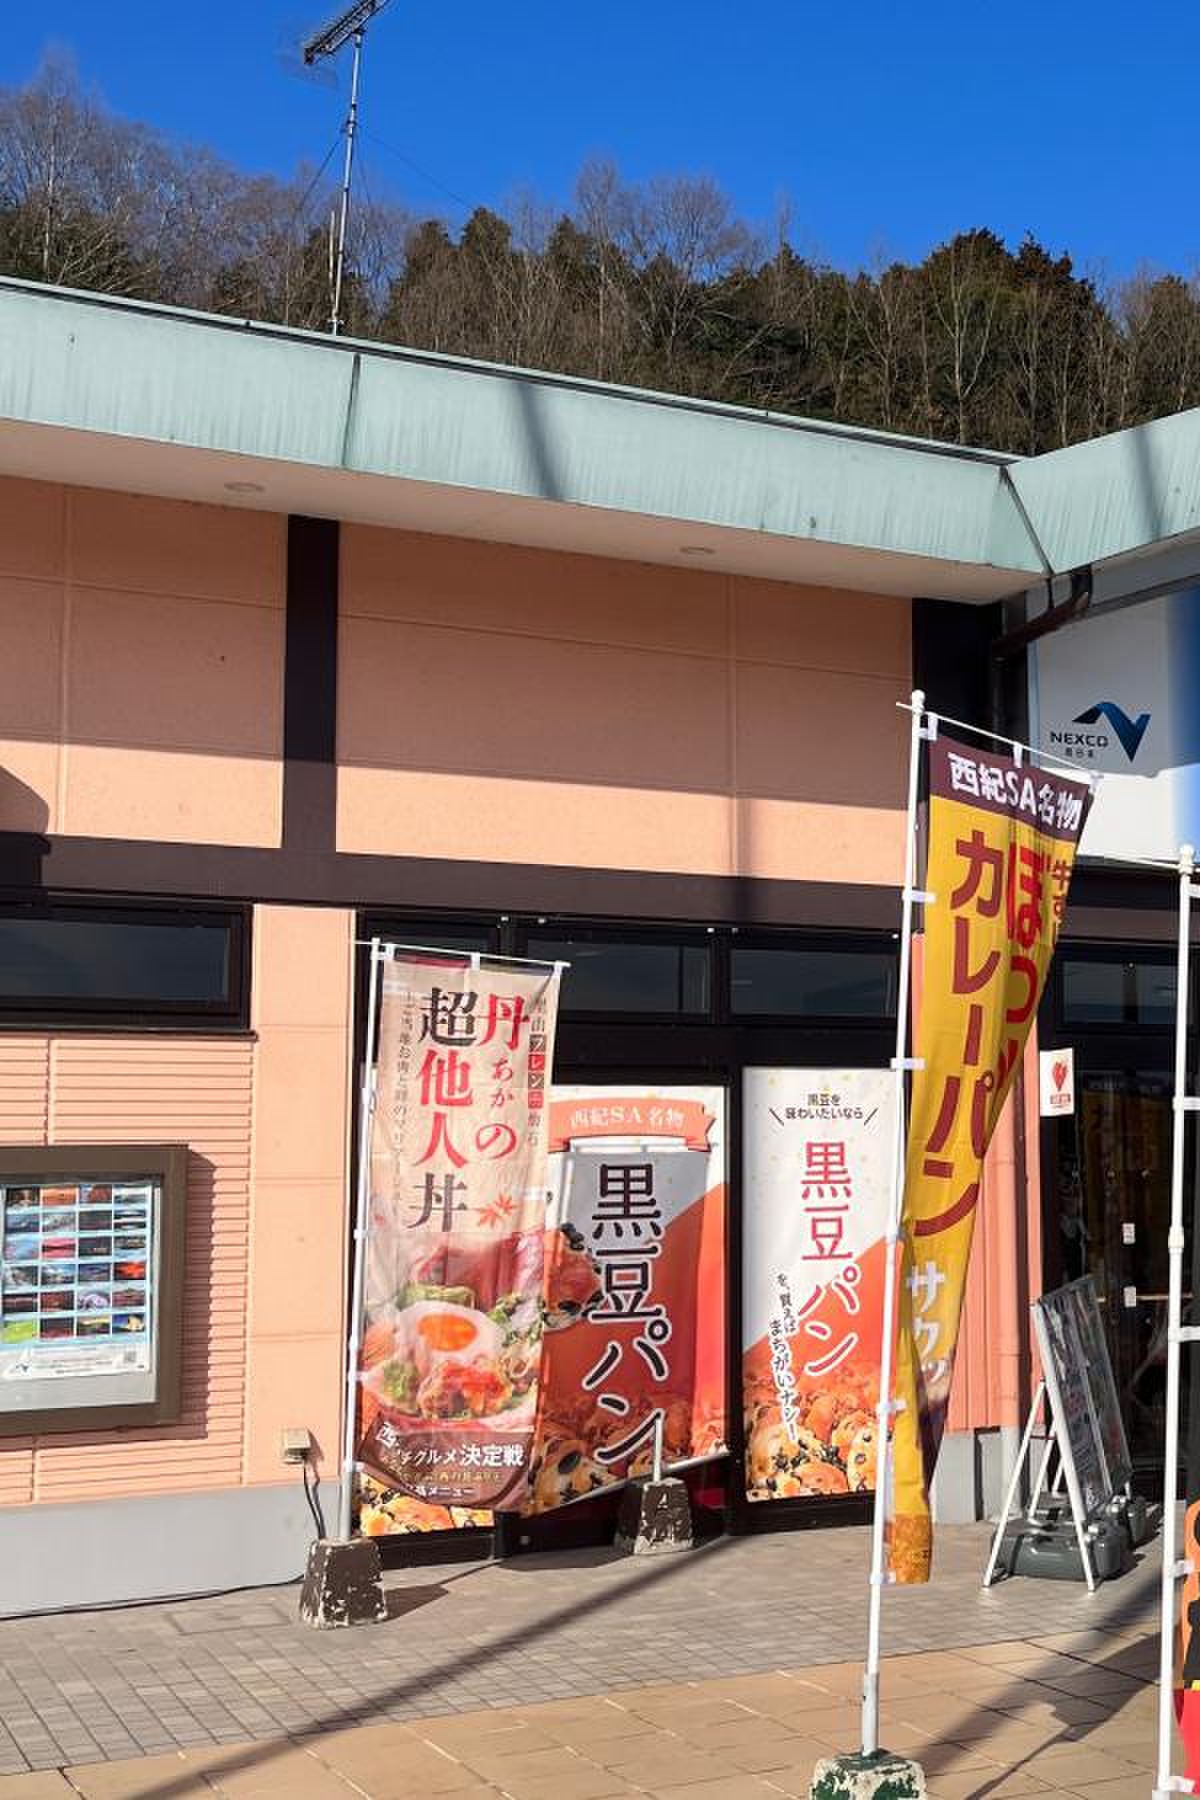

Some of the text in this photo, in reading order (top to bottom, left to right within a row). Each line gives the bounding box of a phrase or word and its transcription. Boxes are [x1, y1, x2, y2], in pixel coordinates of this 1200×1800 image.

[947, 751, 1083, 832] 西紀SA名物
[1050, 731, 1109, 748] NEXCO
[408, 986, 478, 1233] 超他人丼
[913, 830, 1004, 1237] カレーパン
[583, 1162, 672, 1464] 黒豆パン
[798, 1141, 860, 1376] 黒豆パン
